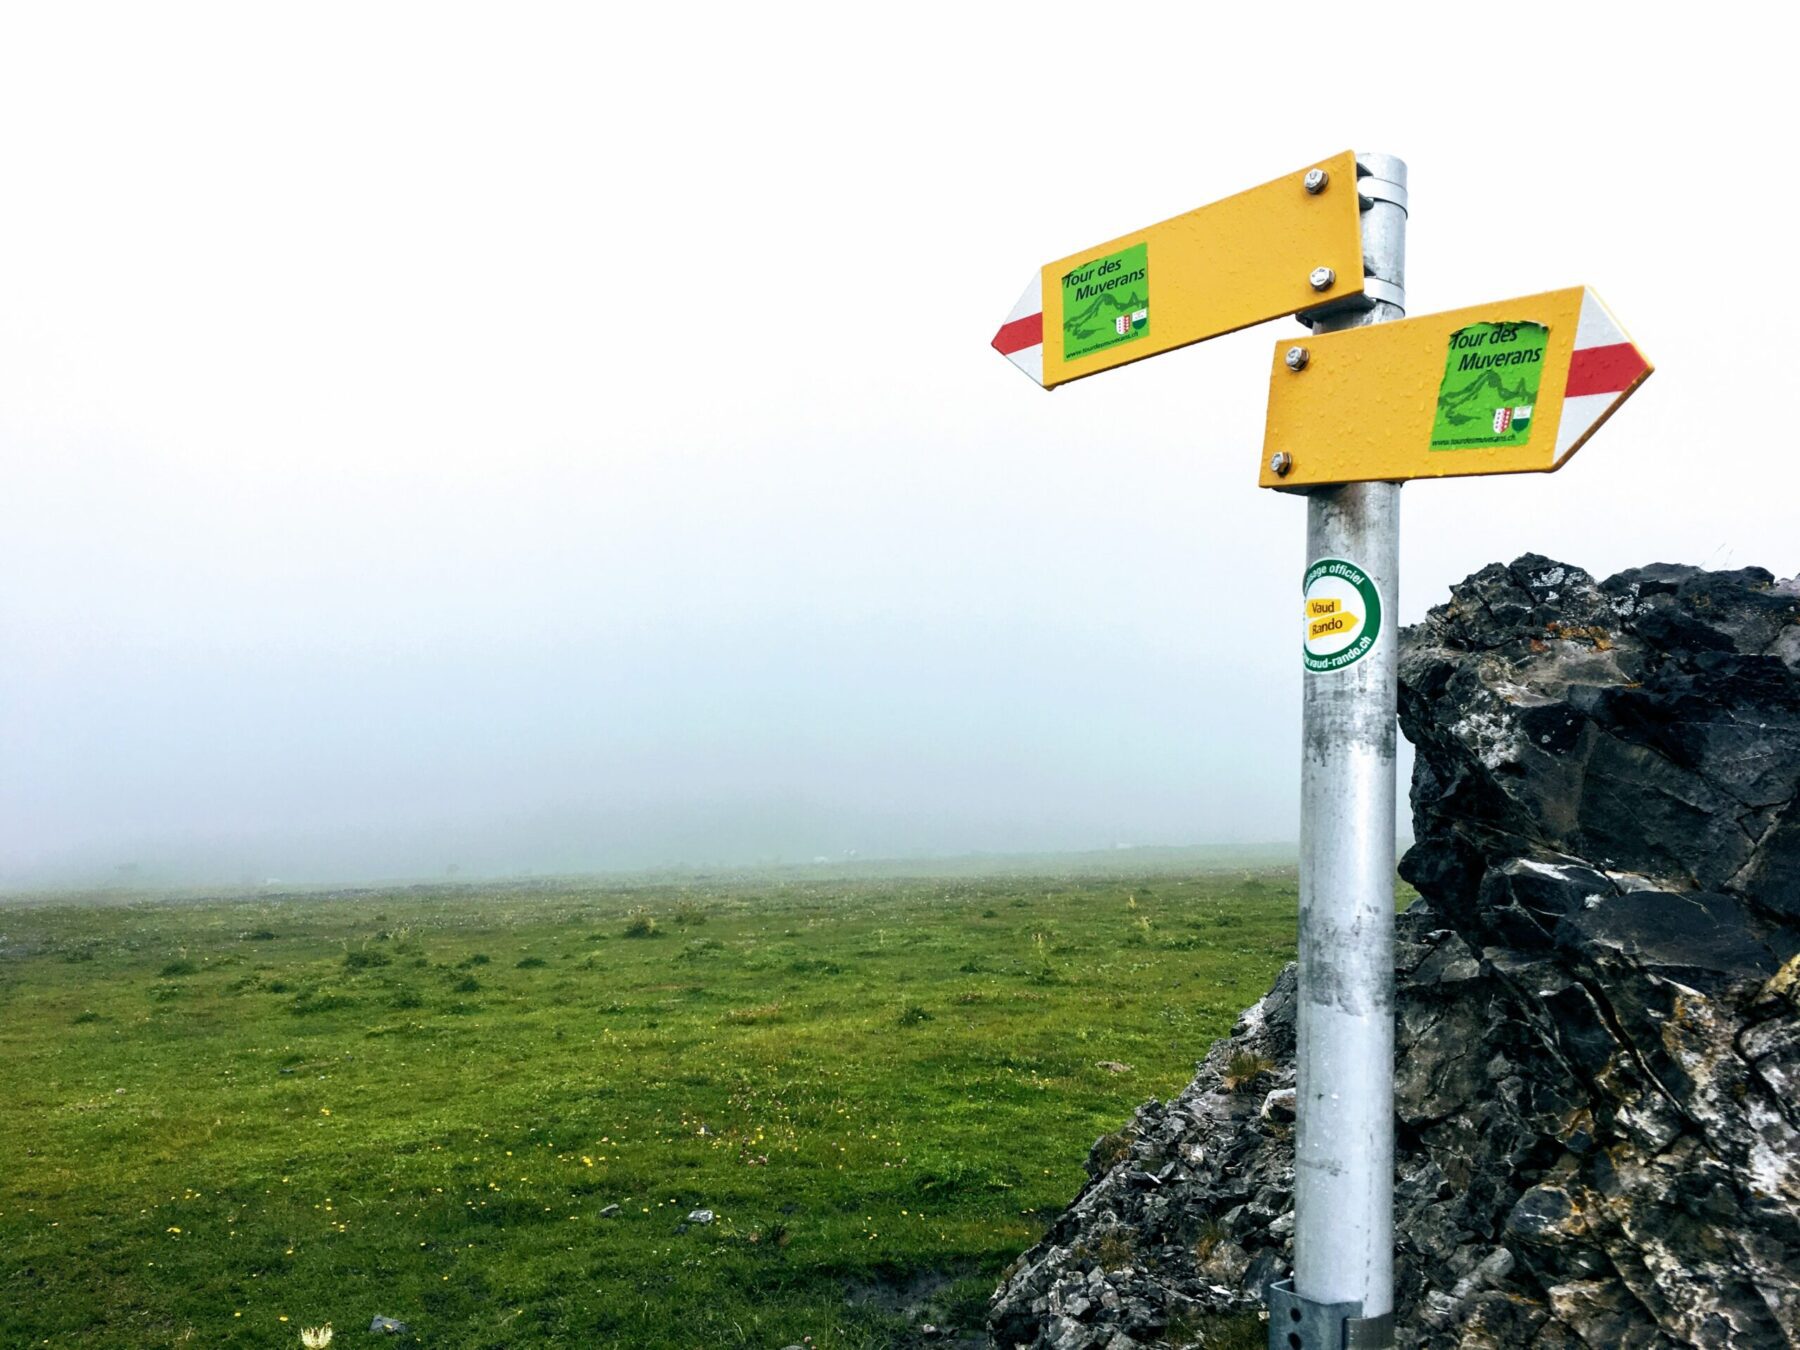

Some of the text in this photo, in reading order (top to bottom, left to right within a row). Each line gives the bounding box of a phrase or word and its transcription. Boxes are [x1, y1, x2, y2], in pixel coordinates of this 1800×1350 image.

[1063, 259, 1122, 288] Tour des
[1075, 268, 1145, 302] Muverans
[1449, 325, 1518, 350] Tour des
[1457, 347, 1543, 371] Muverans
[1329, 564, 1365, 585] officiel
[1312, 601, 1335, 613] Vaud
[1312, 618, 1343, 636] Rando
